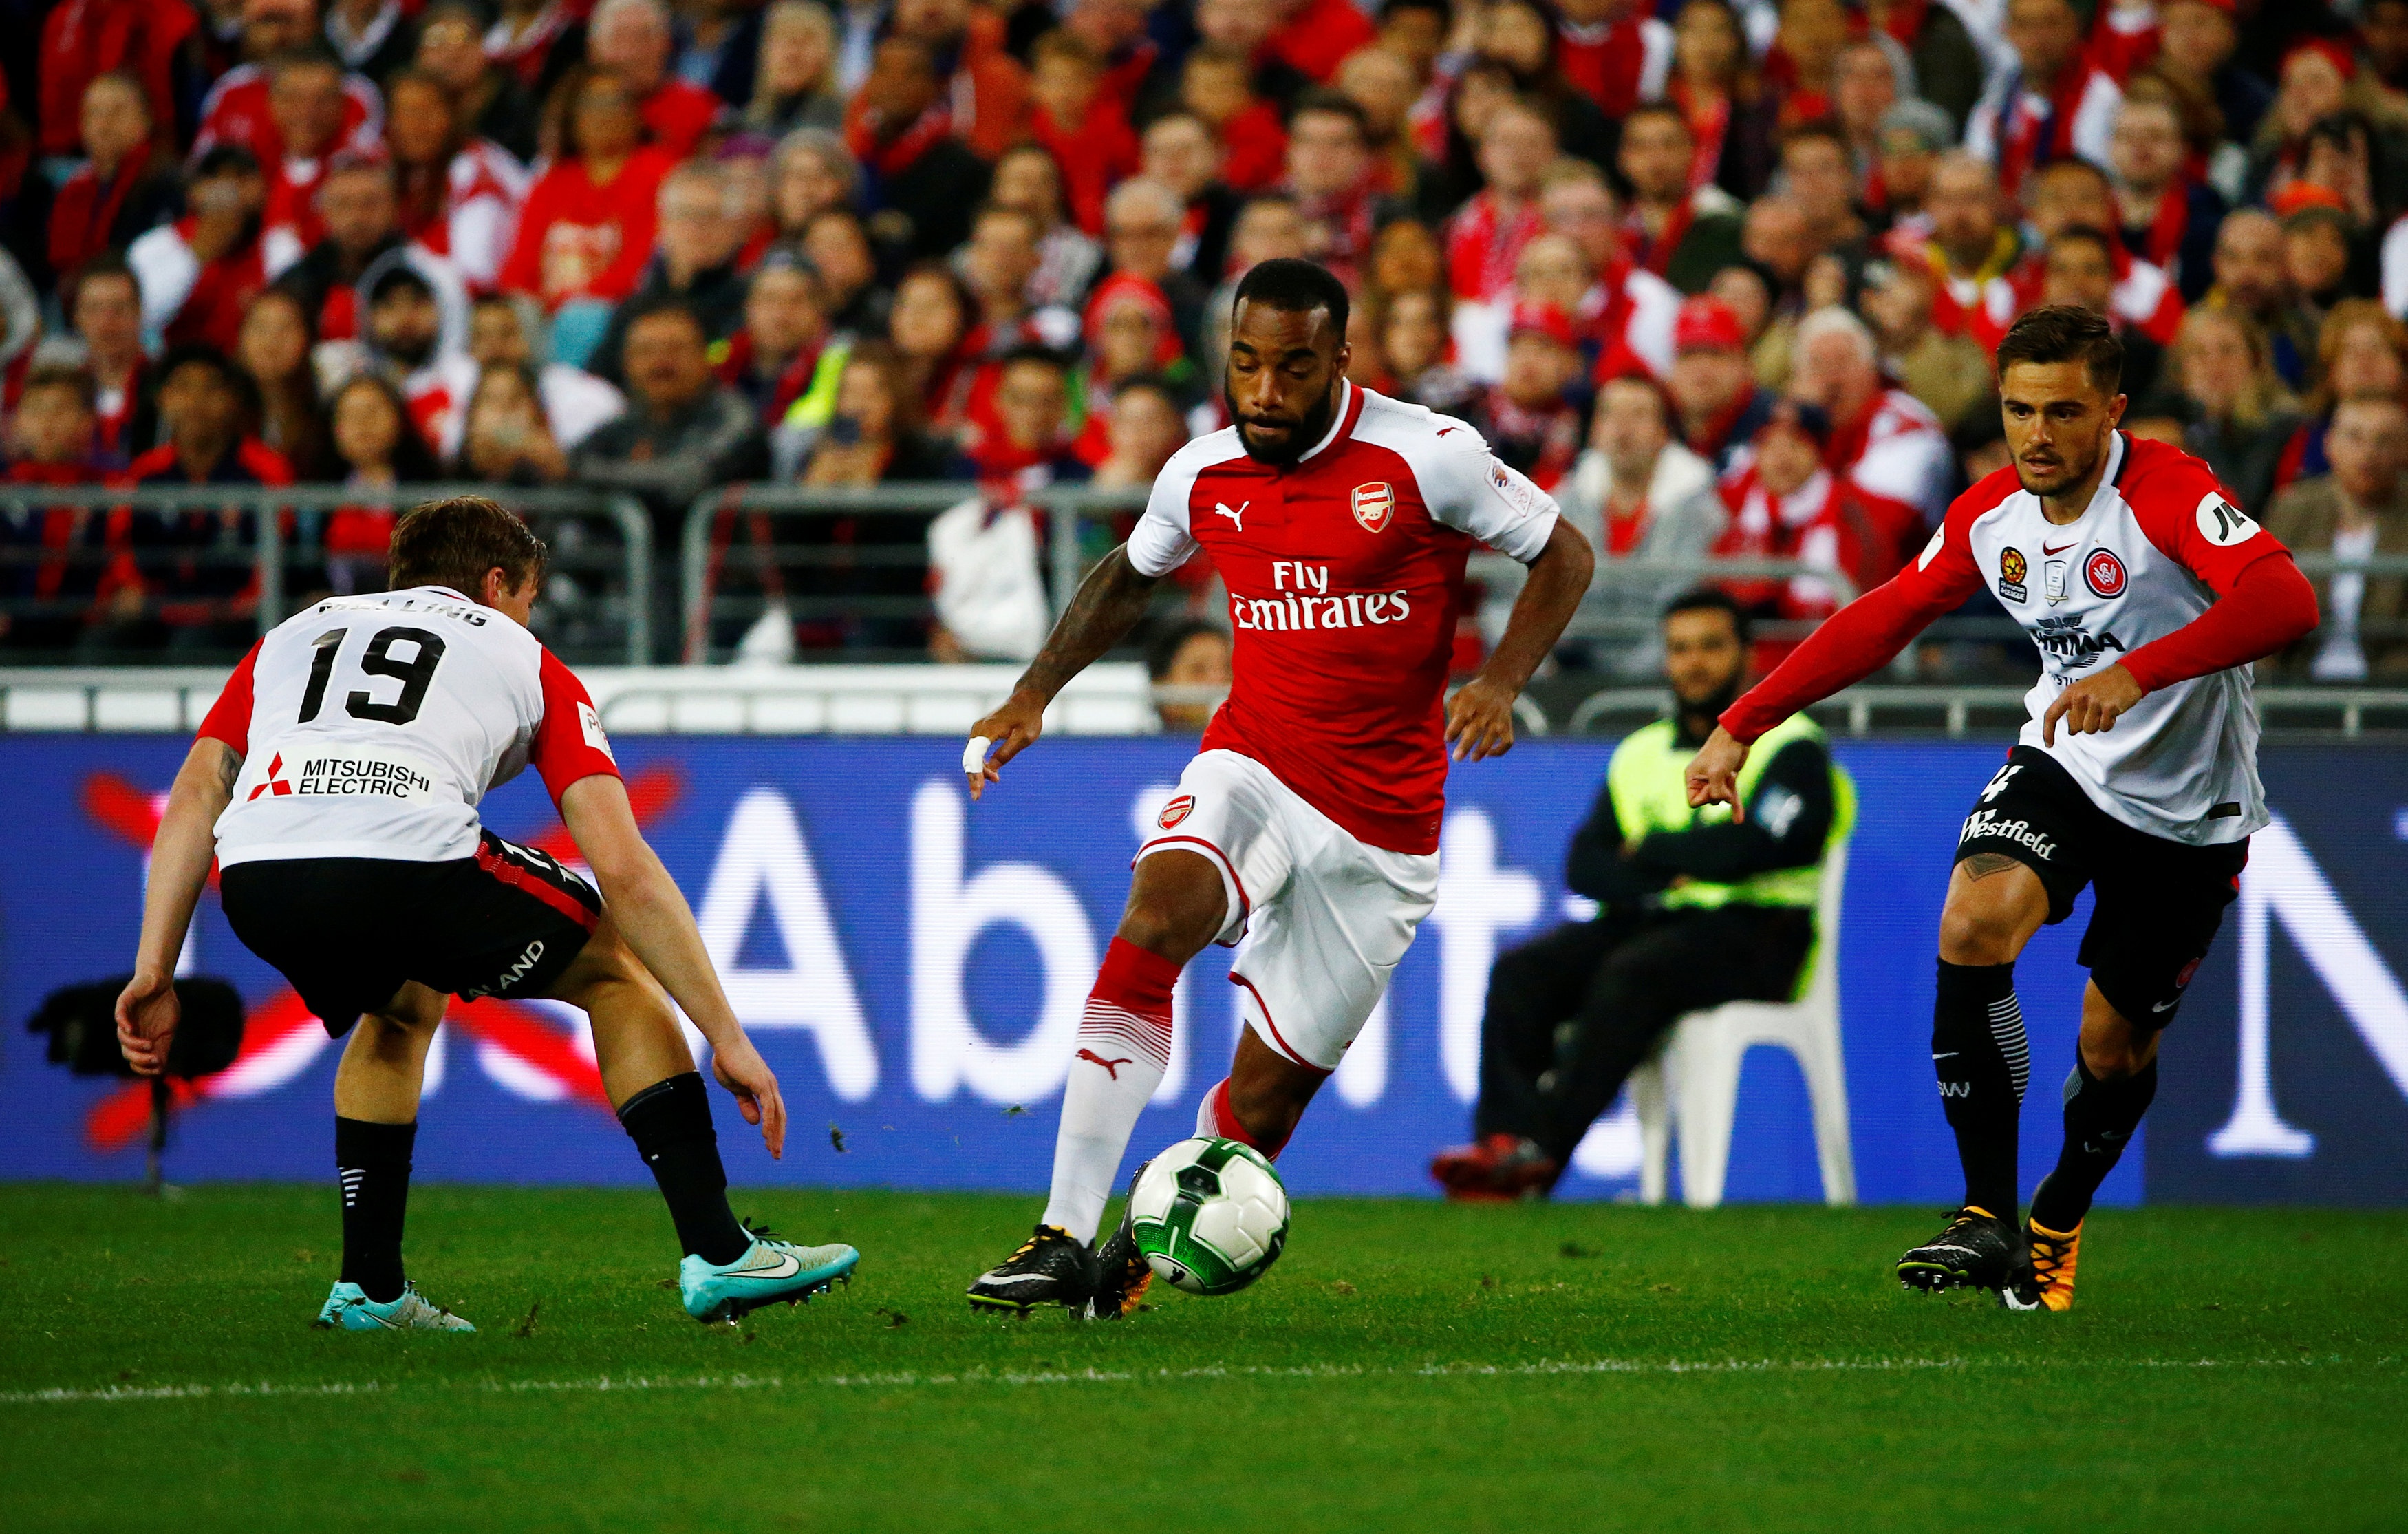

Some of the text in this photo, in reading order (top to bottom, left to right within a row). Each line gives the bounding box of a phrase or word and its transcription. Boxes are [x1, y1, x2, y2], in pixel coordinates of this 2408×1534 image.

[1357, 488, 1388, 501] Arsenal
[1272, 560, 1329, 595] Fly
[1232, 589, 1410, 631] Emirates
[297, 626, 447, 726] 19
[298, 778, 409, 798] ELECTRIC
[302, 758, 430, 793] MITSUBISHI
[1981, 764, 2024, 803] 4
[1958, 809, 2058, 861] Westfield
